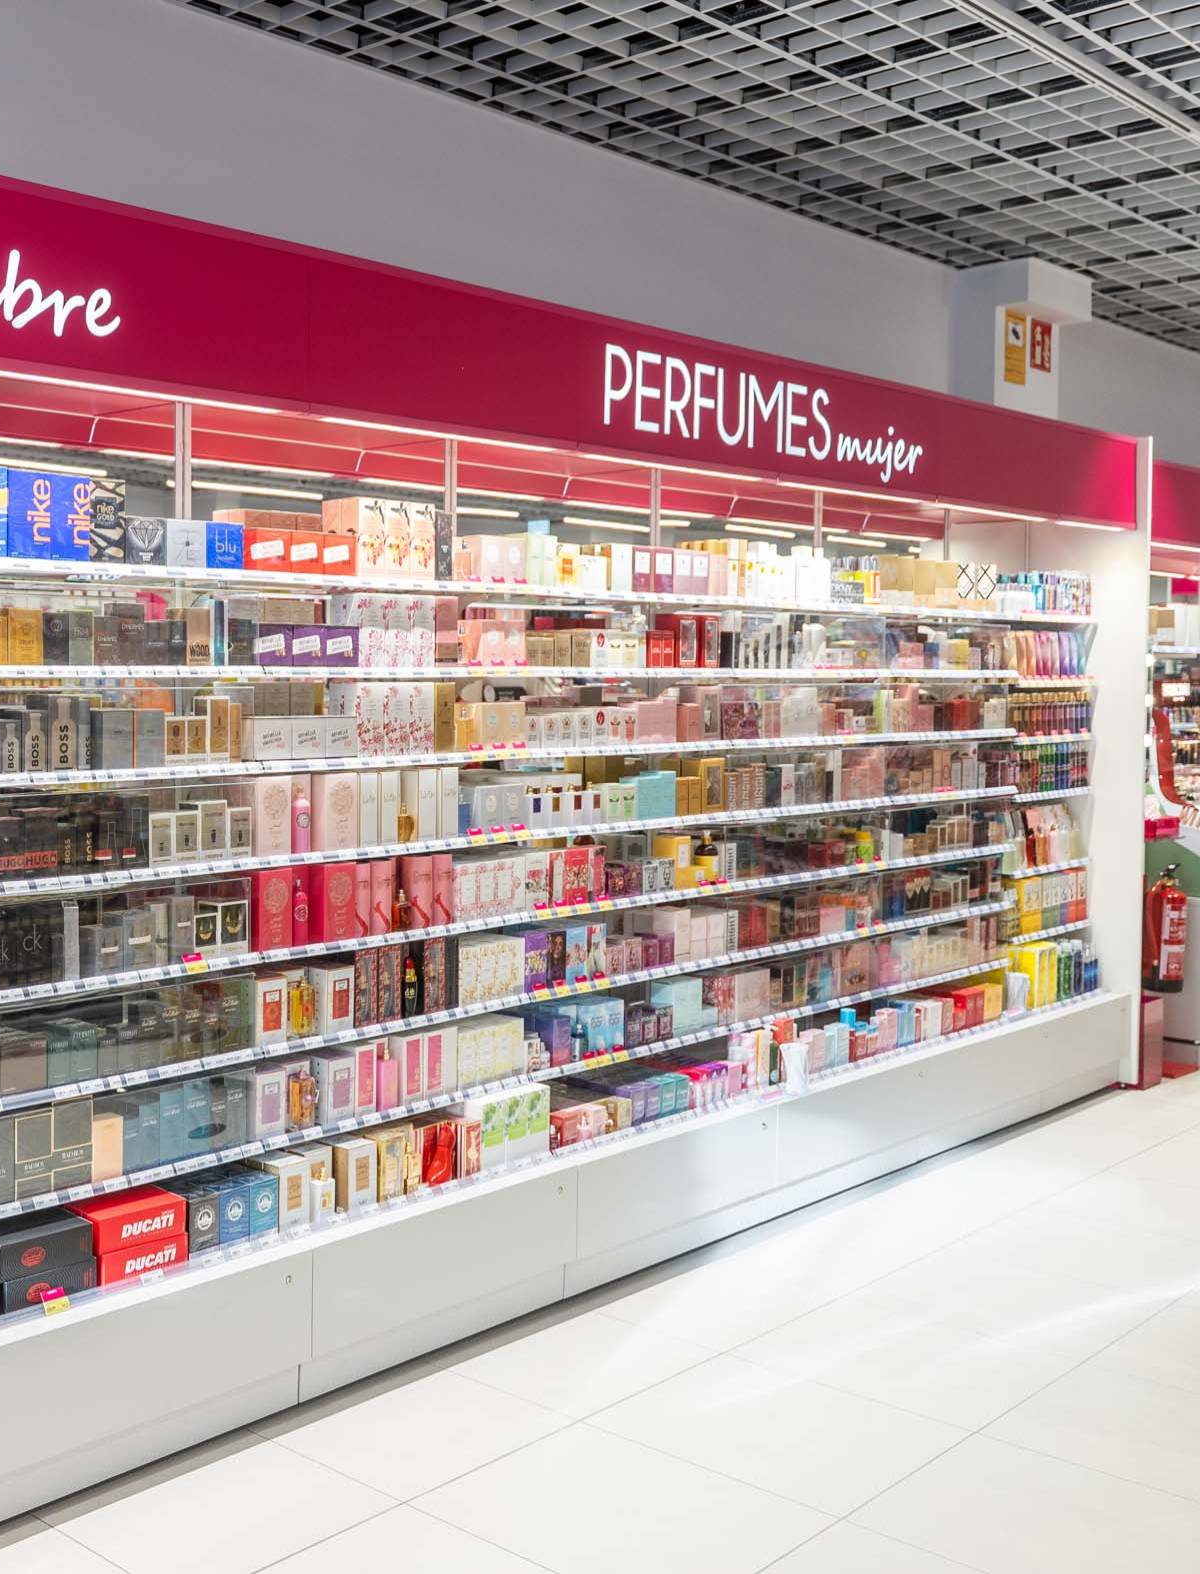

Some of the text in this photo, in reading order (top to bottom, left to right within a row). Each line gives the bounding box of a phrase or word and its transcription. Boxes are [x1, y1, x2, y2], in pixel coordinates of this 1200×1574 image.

[603, 343, 923, 483] PERFUMES mujer
[27, 479, 51, 544] nike
[67, 483, 91, 546] nike
[97, 503, 114, 514] nike
[215, 526, 237, 554] blu
[60, 725, 69, 764] BOSS
[25, 853, 57, 866] HUGO
[22, 924, 43, 952] ck
[121, 1212, 175, 1239] DUCATI
[125, 1247, 177, 1274] DUCATI
